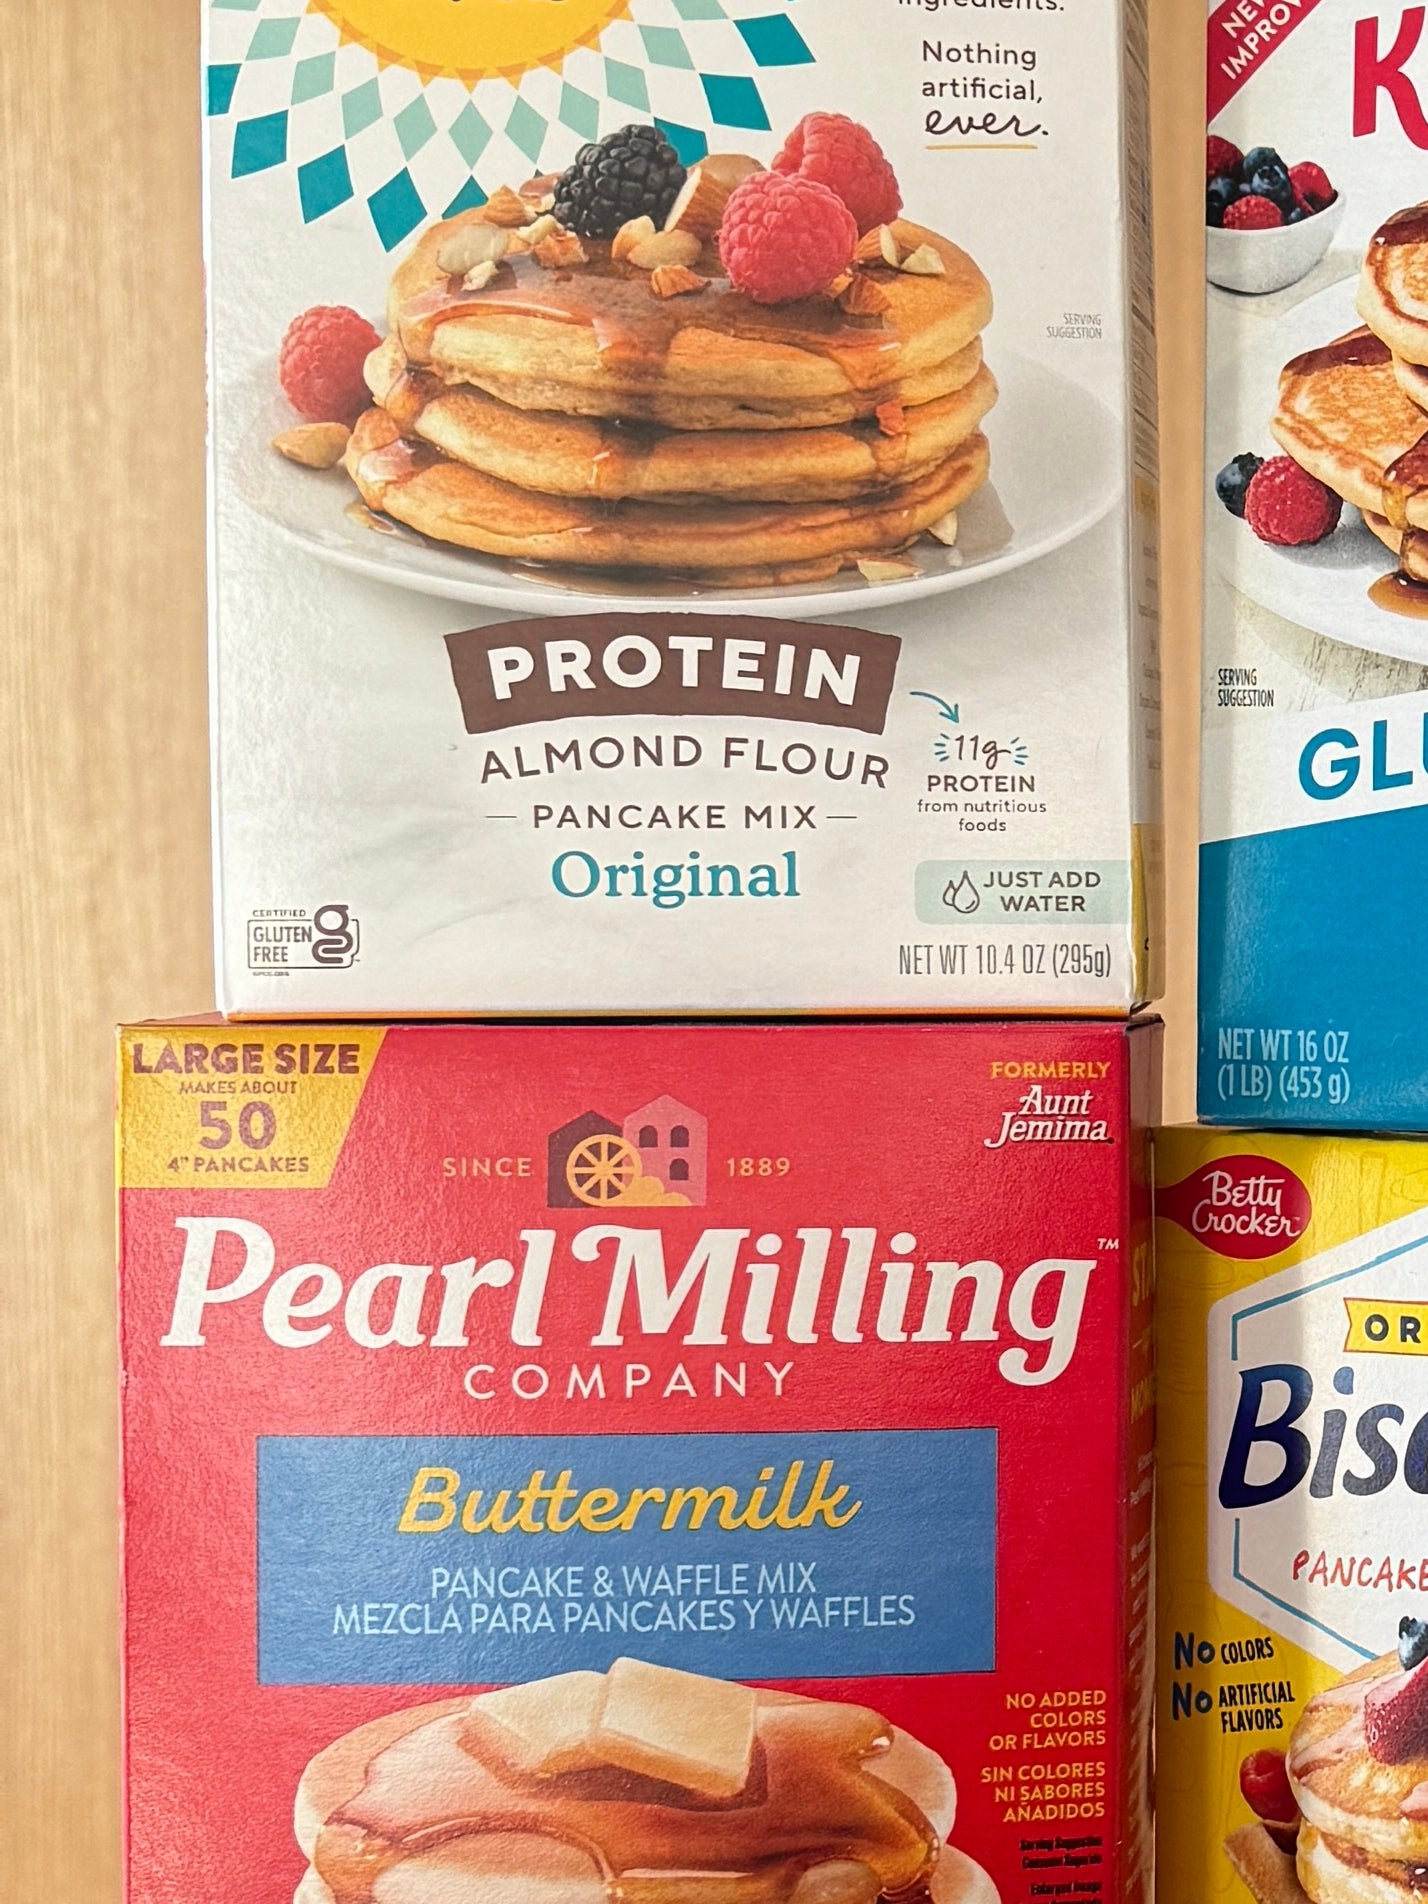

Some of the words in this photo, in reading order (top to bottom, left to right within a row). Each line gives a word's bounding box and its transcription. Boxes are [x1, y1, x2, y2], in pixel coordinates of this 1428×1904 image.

[922, 40, 1037, 71] Nothing
[922, 77, 1042, 104] artificial,
[925, 110, 1049, 137] ever.
[490, 637, 861, 708] PROTEIN
[478, 736, 705, 785] ALMOND
[723, 736, 890, 790] FLOUR
[955, 734, 1011, 770] 11g
[927, 775, 1036, 793] PROTEIN
[533, 803, 730, 831] PANCAKE
[745, 804, 817, 832] MIX
[917, 799, 958, 813] from
[963, 800, 1047, 813] nutritious
[958, 818, 1006, 832] foods
[552, 849, 800, 910] Original
[983, 871, 1043, 888] JUST
[1048, 872, 1101, 888] ADD
[1000, 895, 1086, 912] WATER
[253, 926, 312, 942] GLUTEN
[253, 946, 288, 962] FREE
[132, 1044, 265, 1077] LARGE
[273, 1043, 361, 1076] SIZE
[991, 1061, 1111, 1080] FORMERLY
[178, 1079, 233, 1096] MAKES
[238, 1078, 298, 1096] ABOUT
[1020, 1084, 1093, 1118] Aunt
[199, 1100, 278, 1151] 50
[983, 1112, 1110, 1150] Jemima
[443, 1157, 533, 1179] SINCE
[726, 1156, 793, 1178] 1889
[1203, 1170, 1283, 1211] Betty
[1192, 1199, 1297, 1238] Crocker
[161, 1215, 556, 1350] Pearl
[572, 1217, 1099, 1387] Milling
[464, 1360, 797, 1401] COMPANY
[397, 1459, 865, 1537] Buttermilk
[431, 1565, 586, 1599] PANCAKE
[594, 1566, 614, 1598] &
[620, 1565, 751, 1599] WAFFLE
[756, 1561, 818, 1596] MIX
[1221, 1636, 1275, 1664] COLORS
[1006, 1693, 1035, 1709] NO
[1039, 1690, 1106, 1708] ADDED
[1219, 1682, 1296, 1706] ARTIFICIAL
[1030, 1710, 1106, 1728] COLORS
[1221, 1708, 1284, 1733] FLAVORS
[989, 1734, 1017, 1750] OR
[1022, 1730, 1106, 1749] FLAVORS
